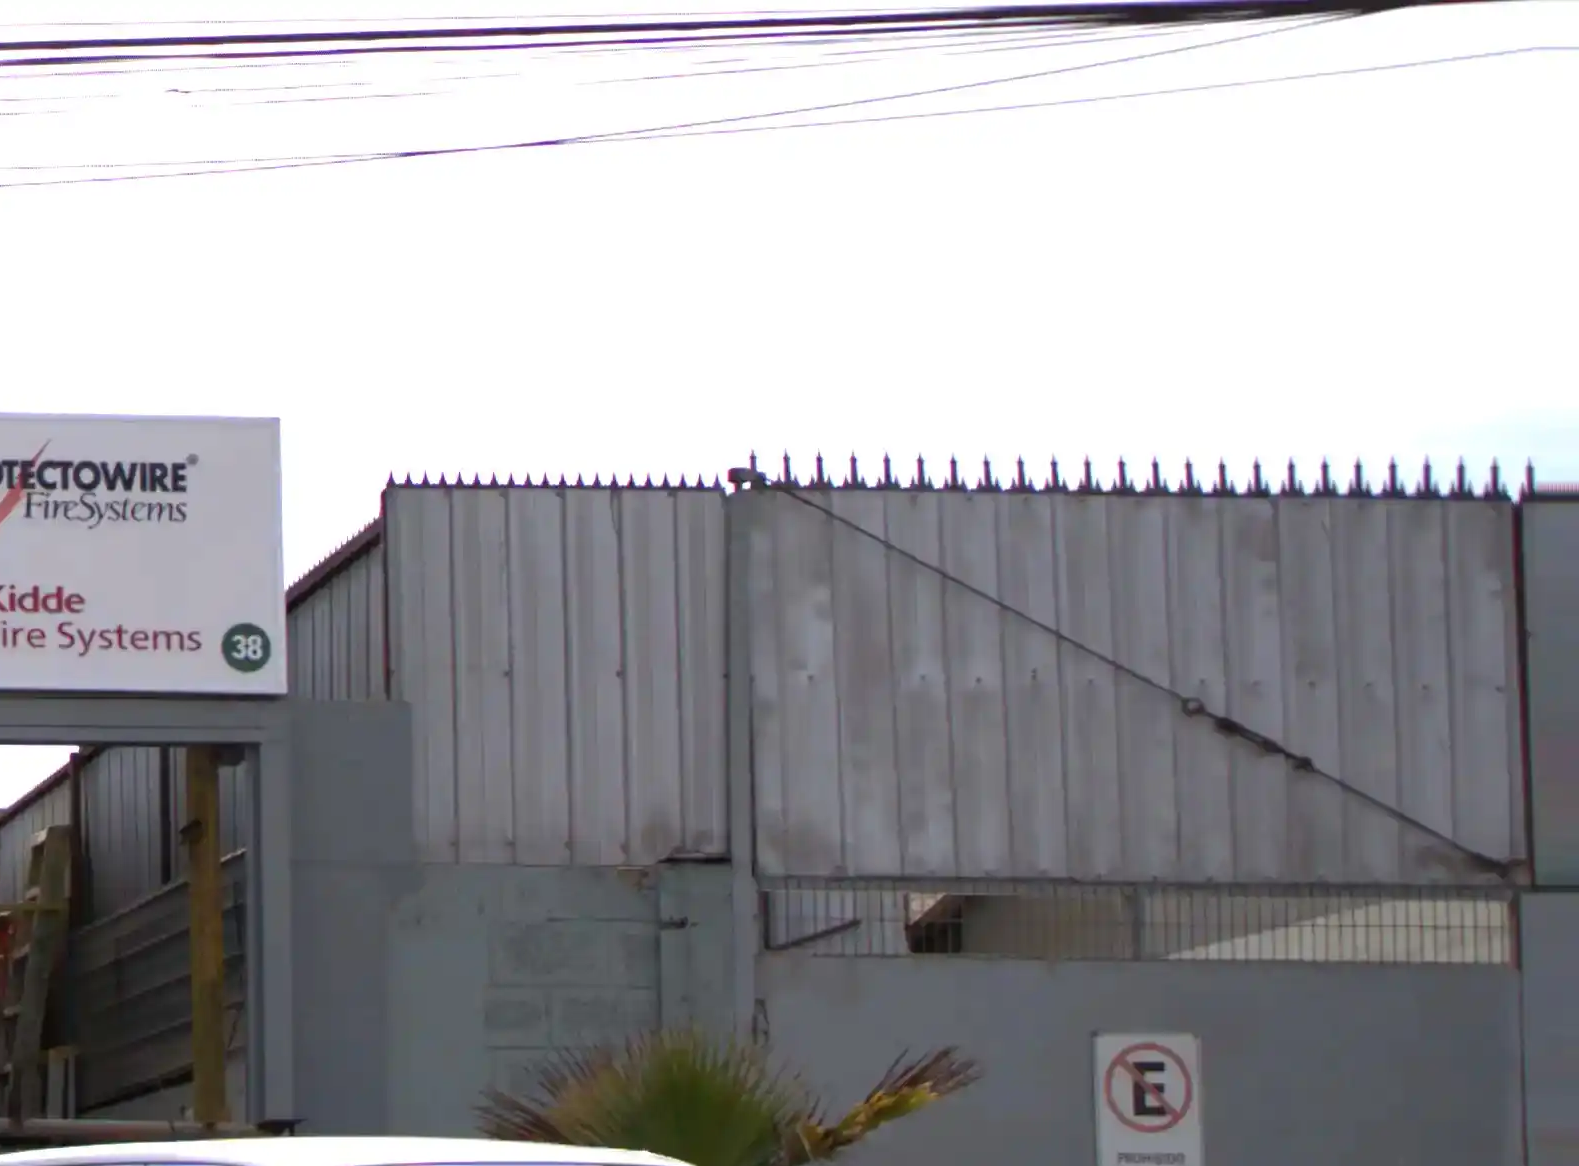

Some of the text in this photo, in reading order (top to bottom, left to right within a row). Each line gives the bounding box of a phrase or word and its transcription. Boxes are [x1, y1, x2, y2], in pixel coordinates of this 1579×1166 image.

[23, 492, 187, 529] FireSystems
[57, 621, 202, 657] Systems
[231, 634, 263, 661] 38
[1133, 1062, 1167, 1117] E
